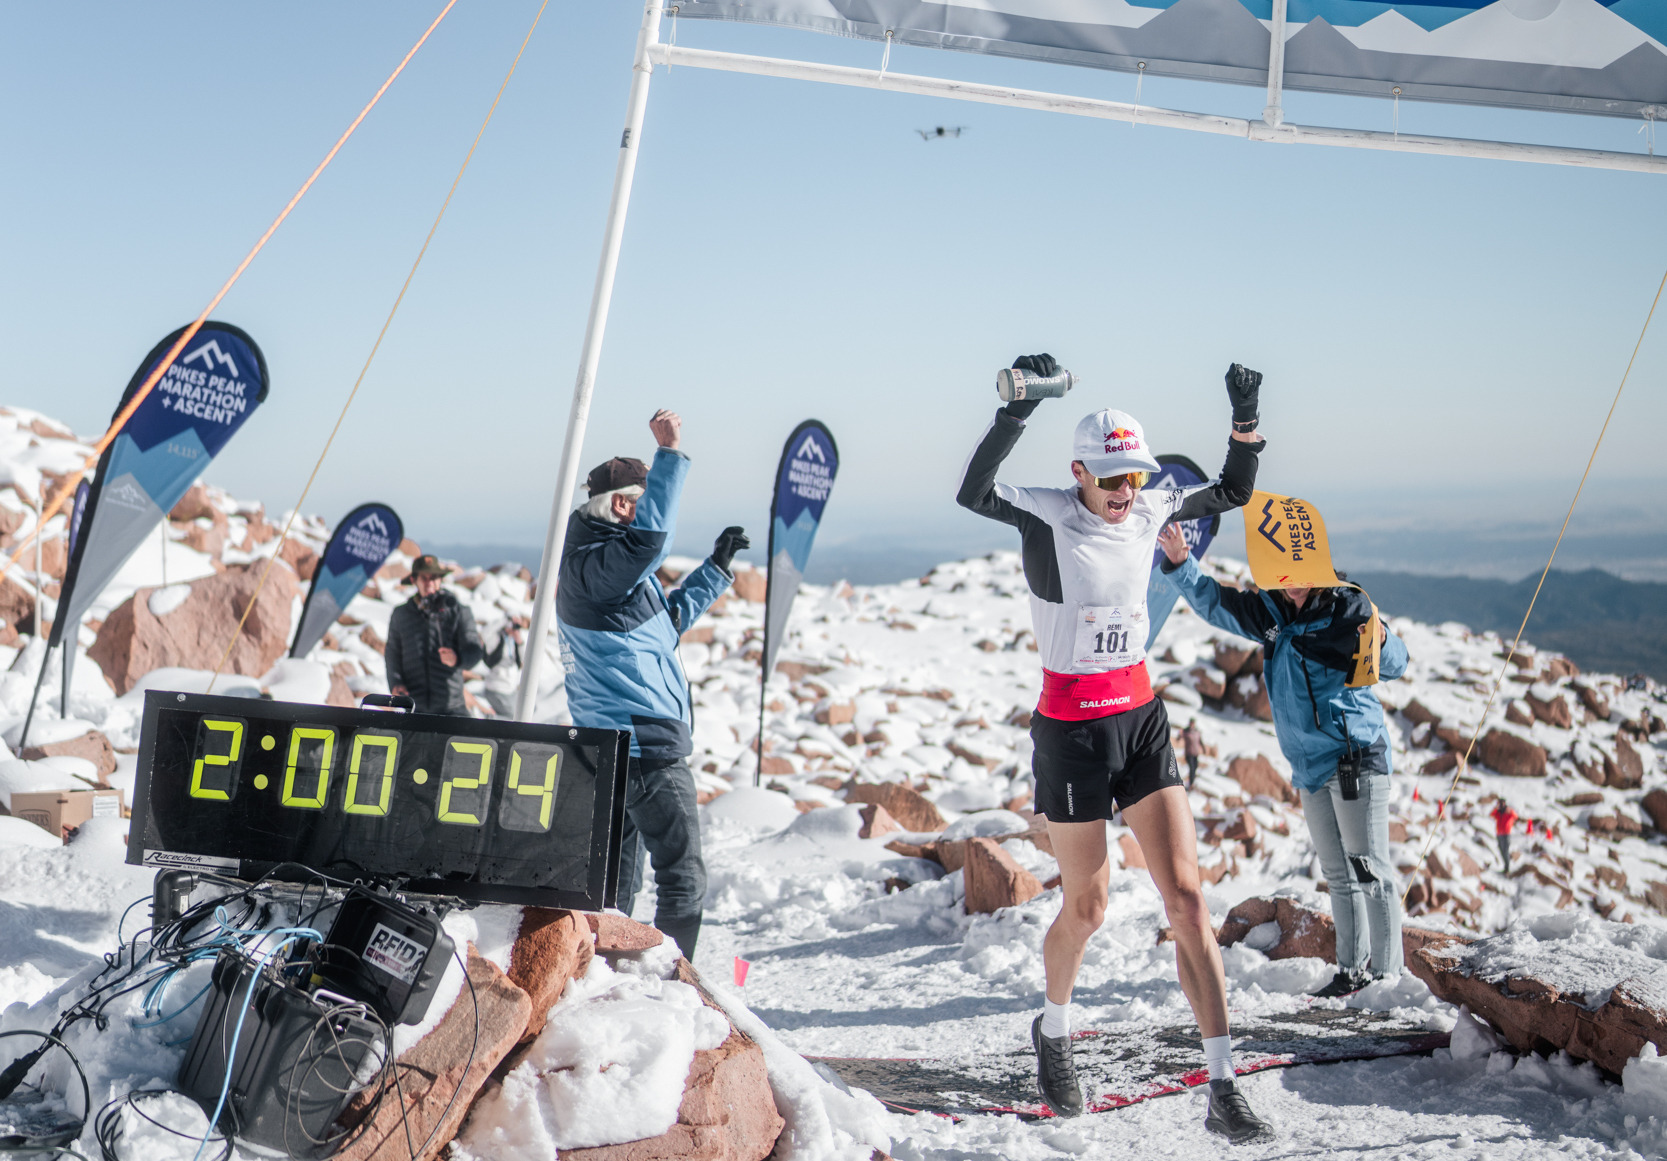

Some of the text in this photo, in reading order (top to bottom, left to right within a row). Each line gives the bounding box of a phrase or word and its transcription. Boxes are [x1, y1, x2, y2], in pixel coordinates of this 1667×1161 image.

[158, 376, 247, 413] MARATHON
[168, 363, 247, 397] PIKES PEAK
[1023, 375, 1060, 386] SALOMO
[173, 397, 236, 425] ASCENT
[1105, 440, 1141, 454] Red Bull
[1289, 523, 1304, 561] PIKES
[1094, 631, 1128, 654] 101
[1080, 696, 1131, 709] SALOMON
[1066, 782, 1074, 816] SALOMON
[371, 929, 417, 963] RFID
